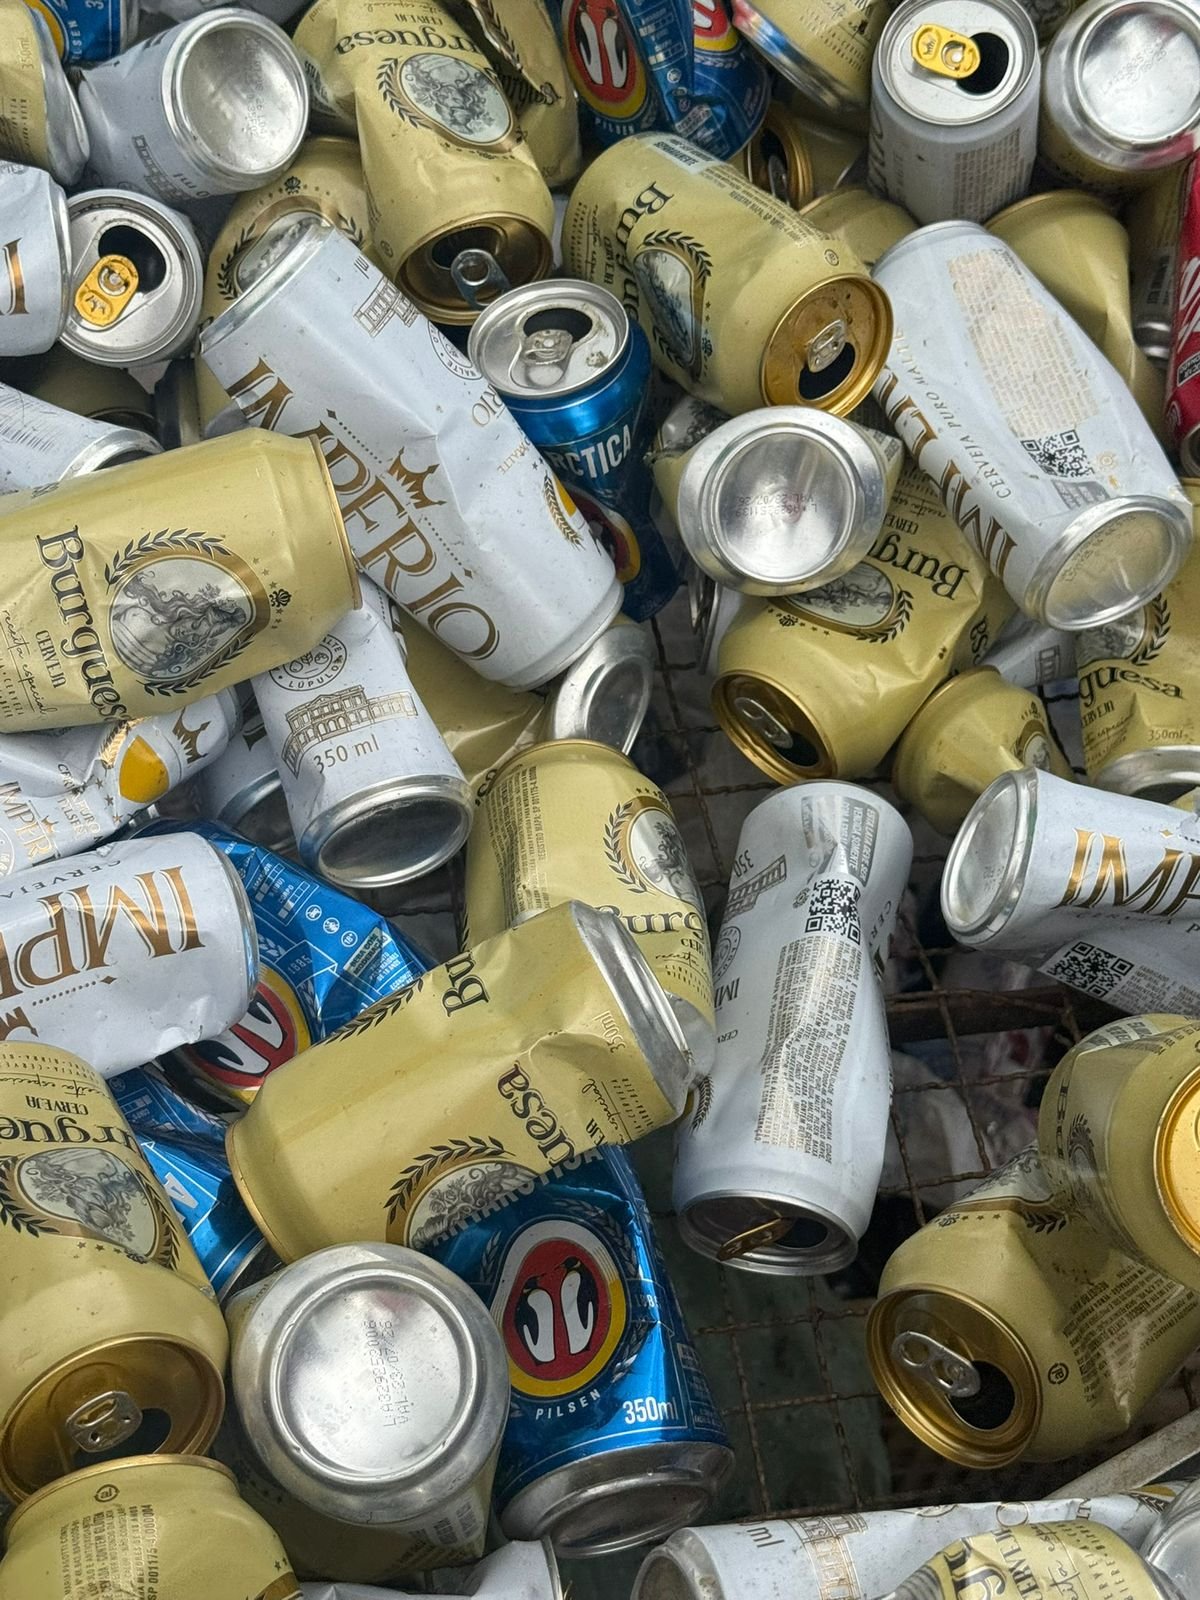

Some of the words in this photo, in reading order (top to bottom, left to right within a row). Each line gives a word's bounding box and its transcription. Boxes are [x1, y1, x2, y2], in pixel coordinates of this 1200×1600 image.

[335, 25, 480, 54] urguesa
[926, 391, 962, 430] PURO
[959, 434, 1012, 500] CERVEJA
[882, 512, 918, 534] CERVE
[35, 524, 131, 722] Burgues
[35, 629, 68, 690] CERVEJA
[17, 663, 57, 715] especial
[1077, 666, 1187, 708] guesa
[1081, 699, 1116, 728] ERVEJA
[1148, 728, 1186, 741] 350ml
[312, 743, 350, 775] 350
[351, 733, 380, 758] ml
[851, 806, 864, 835] VENDIDA
[865, 808, 875, 826] ESTA
[534, 831, 546, 860] REGISTRO
[863, 826, 873, 844] LATA
[849, 835, 860, 870] SOMENTE
[861, 844, 871, 864] DEVE
[852, 950, 862, 980] FABRICADO
[814, 1001, 826, 1026] CONTÉM
[840, 990, 849, 1008] FILIAL
[845, 990, 855, 1020] ENVASADO
[803, 1023, 812, 1040] LOTE:
[803, 1027, 818, 1063] DERIVADOS
[801, 1064, 809, 1074] DE
[816, 1045, 829, 1072] CERVEJA
[827, 1038, 846, 1095] RESPONSABILIDADE
[25, 1095, 90, 1116] CERVEJA
[497, 1059, 576, 1167] uesa
[581, 1077, 620, 1130] especial
[826, 1097, 832, 1105] DE
[806, 1122, 811, 1131] DE
[535, 1388, 601, 1421] PILSEN
[622, 1396, 679, 1425] 350ml
